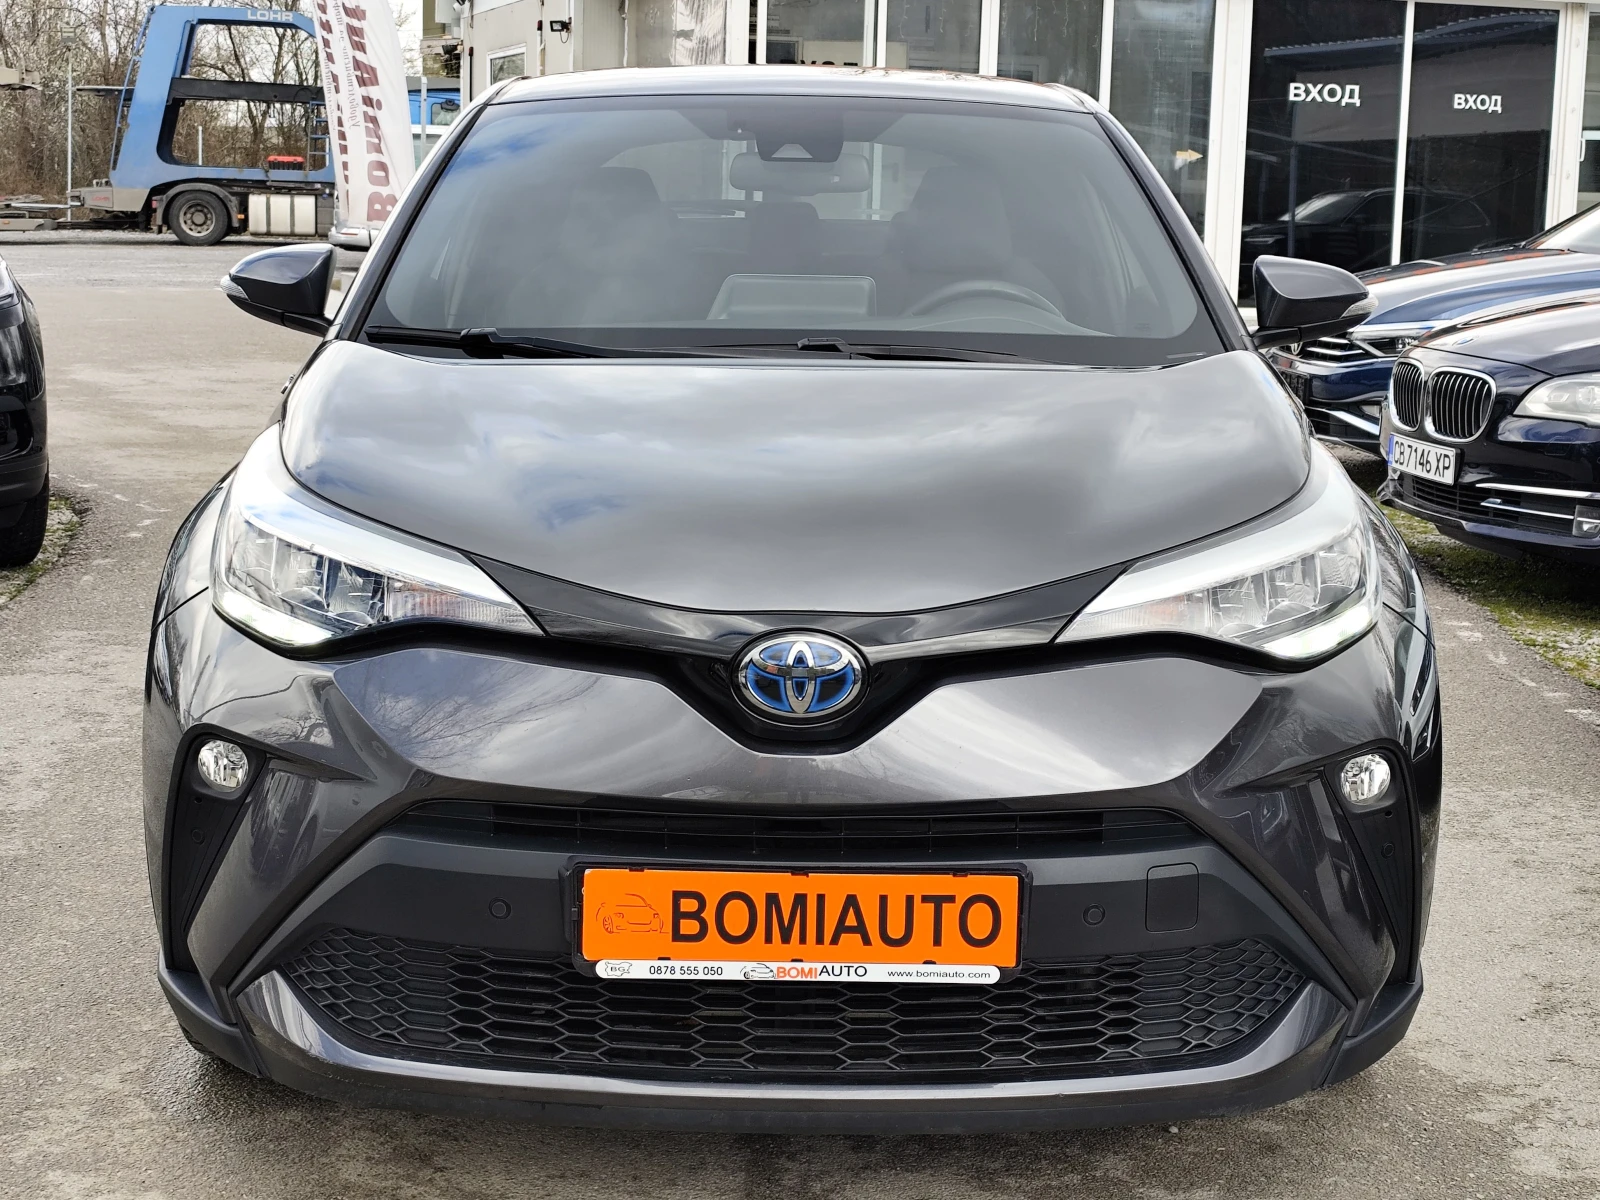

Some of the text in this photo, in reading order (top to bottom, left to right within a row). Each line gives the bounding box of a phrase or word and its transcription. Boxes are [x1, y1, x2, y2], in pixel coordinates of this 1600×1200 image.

[247, 9, 293, 22] LOHR
[1289, 82, 1361, 107] ВХОД
[1453, 93, 1502, 113] ВХОД
[671, 889, 1002, 948] BOMIAUTO
[649, 965, 723, 976] 0878 555 050
[887, 969, 991, 979] www.bomiauto.com
